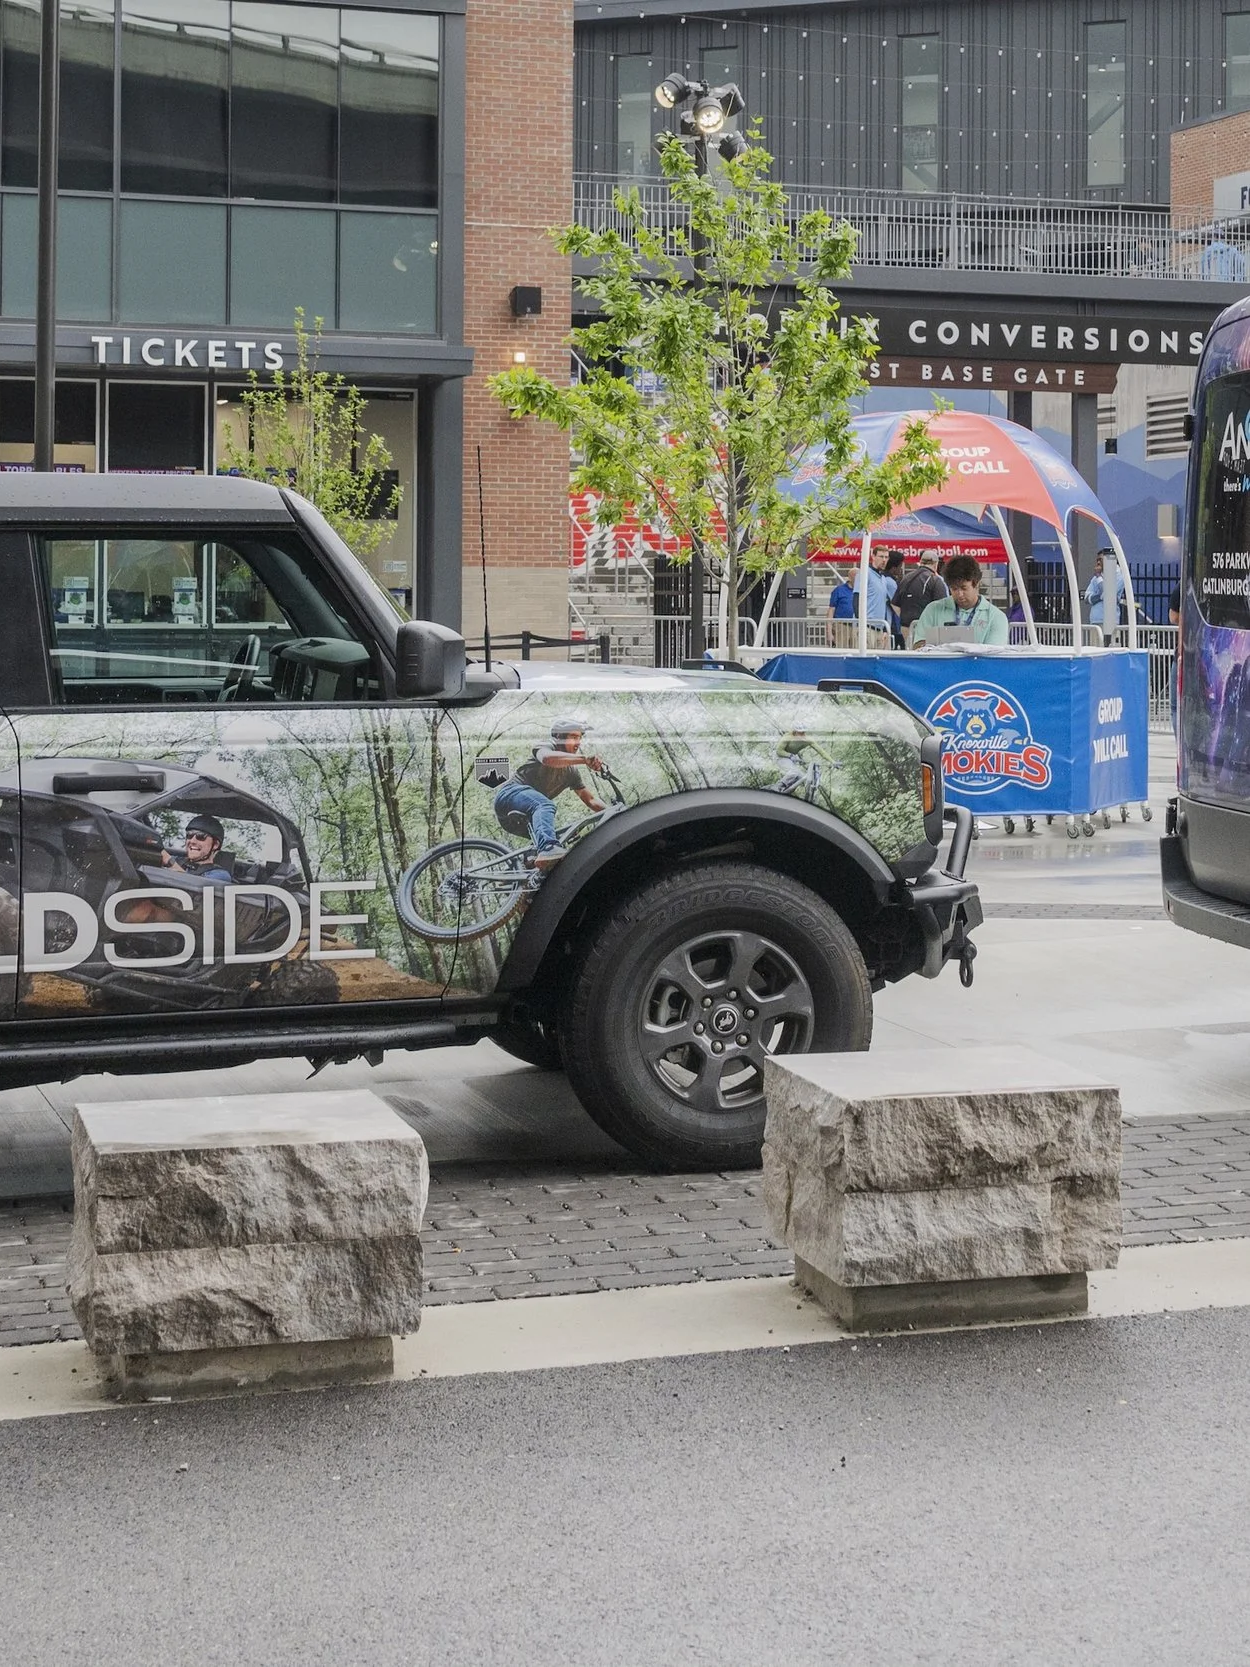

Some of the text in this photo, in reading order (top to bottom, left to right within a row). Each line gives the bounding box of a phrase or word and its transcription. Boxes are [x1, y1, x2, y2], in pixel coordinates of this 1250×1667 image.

[908, 319, 1204, 355] CONVERSIONS
[91, 335, 284, 370] TICKETS
[869, 362, 1085, 386] ST BASE GATE
[920, 446, 991, 458] ROUP
[957, 460, 1010, 475] CALL
[1212, 552, 1224, 569] 576
[1098, 697, 1123, 724] GROUP
[942, 732, 1010, 754] Knoxville
[1092, 734, 1129, 764] WILL CALL
[942, 746, 1048, 785] MOKIES
